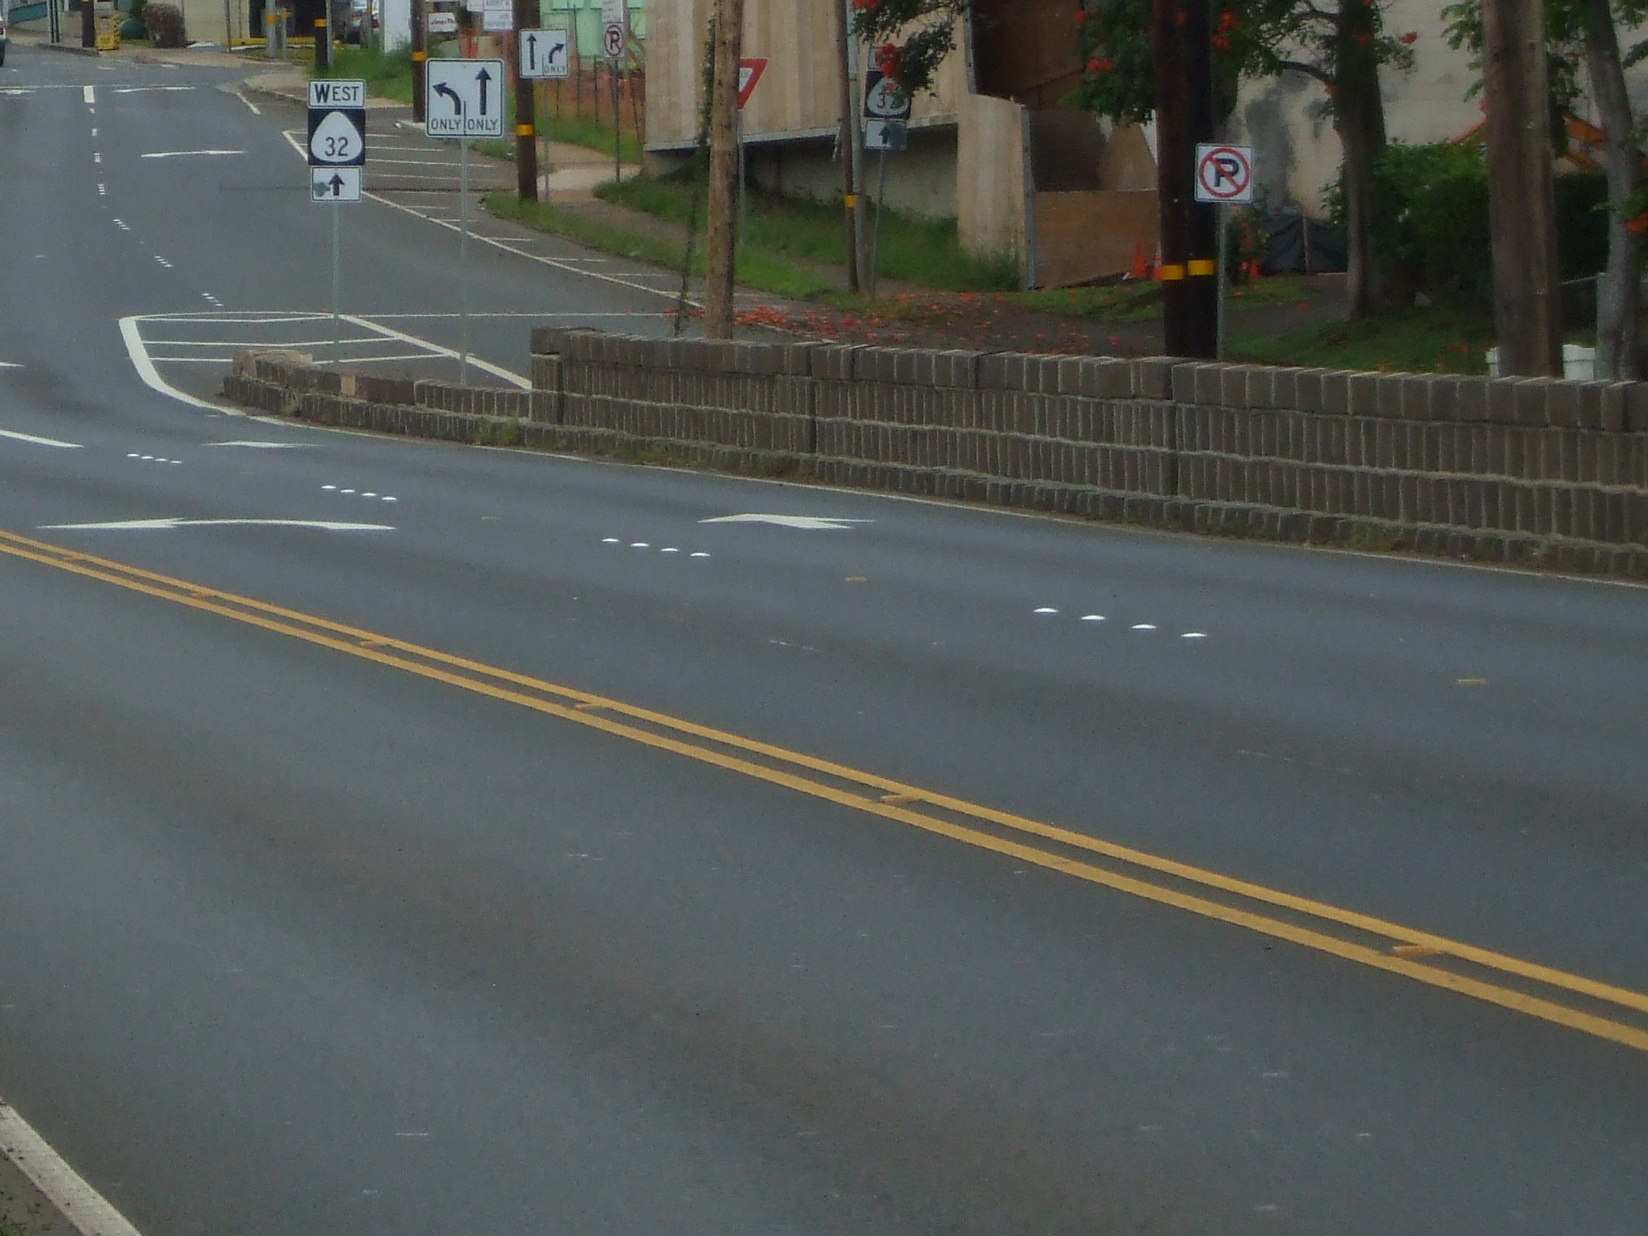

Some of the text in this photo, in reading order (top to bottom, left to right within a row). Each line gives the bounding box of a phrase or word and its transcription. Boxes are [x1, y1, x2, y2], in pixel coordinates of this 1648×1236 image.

[544, 65, 566, 74] ONLY
[314, 83, 360, 104] WEST
[431, 119, 462, 131] ONLY
[467, 119, 499, 131] ONLY
[324, 136, 349, 157] 32
